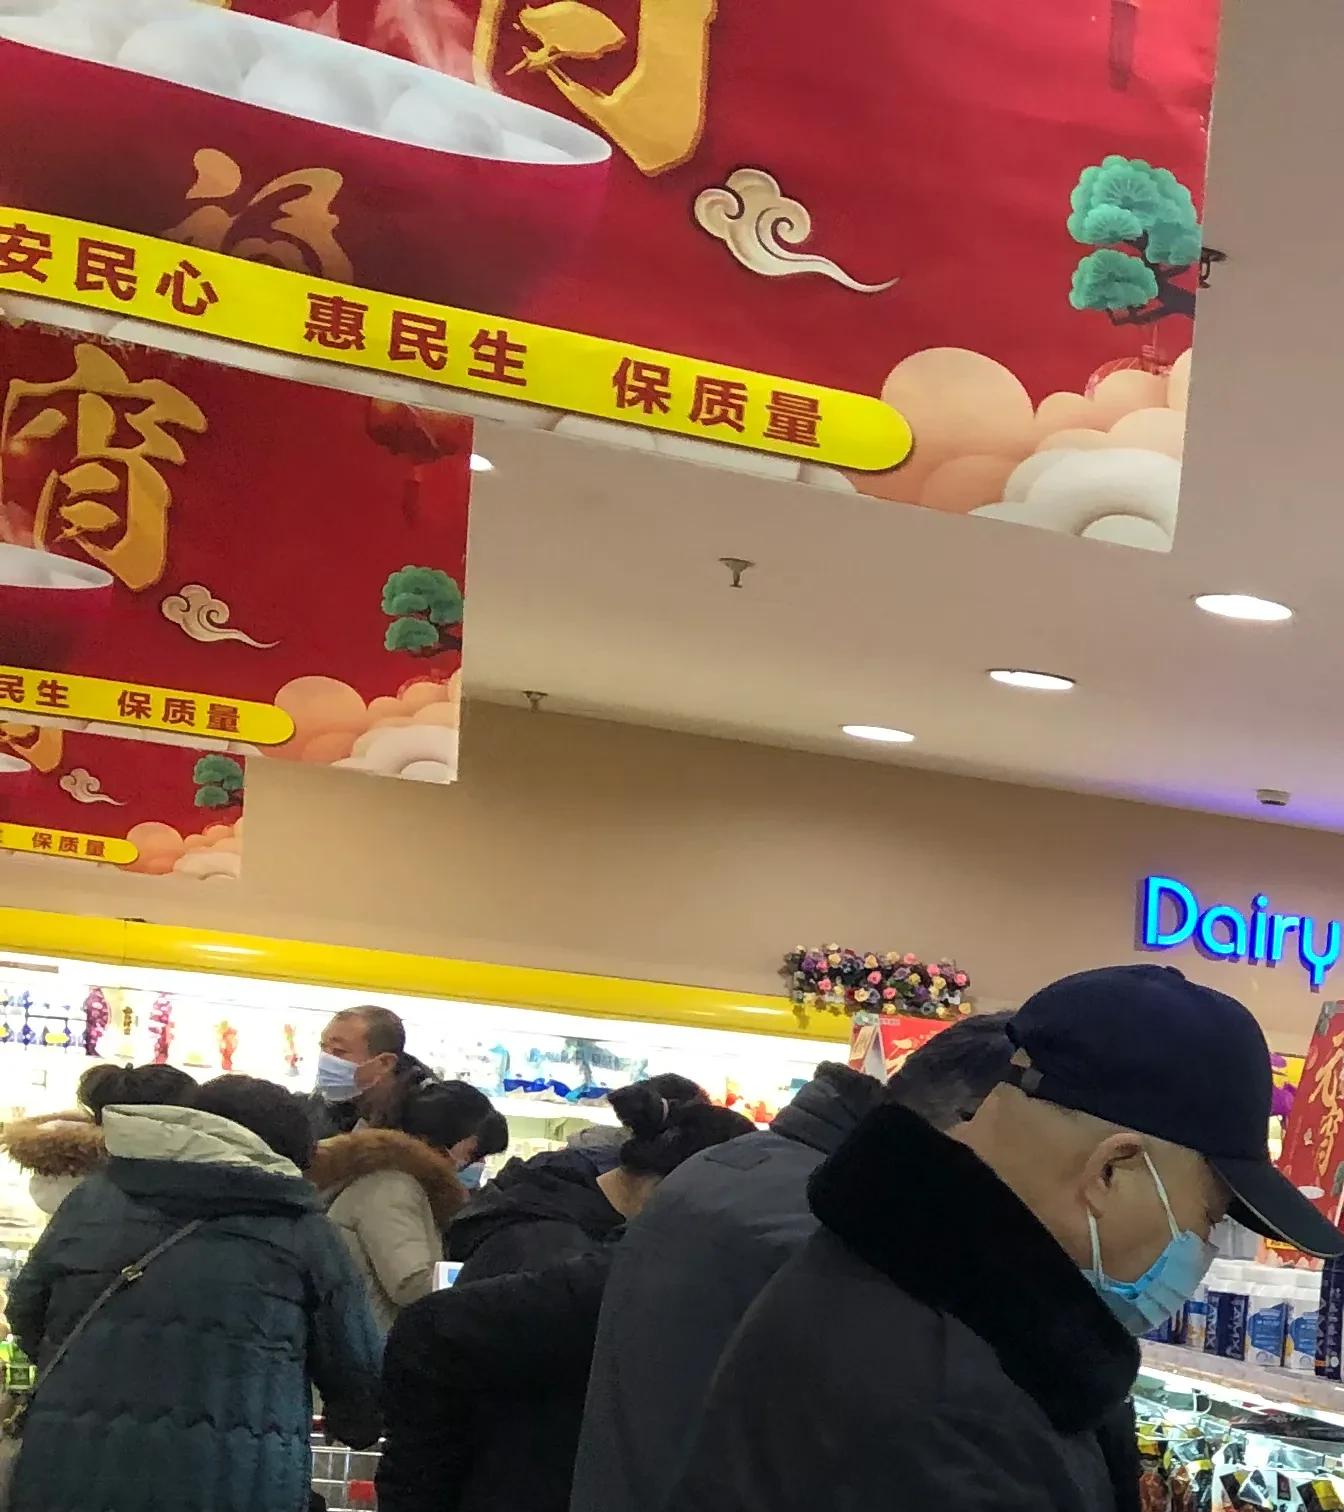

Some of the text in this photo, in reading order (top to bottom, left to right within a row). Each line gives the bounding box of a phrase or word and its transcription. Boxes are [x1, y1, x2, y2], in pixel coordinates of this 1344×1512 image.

[0, 223, 824, 450] 安民心 惠民生 保质量
[117, 689, 241, 734] 保质量
[32, 831, 106, 858] 保质量
[1143, 874, 1342, 989] Dairy
